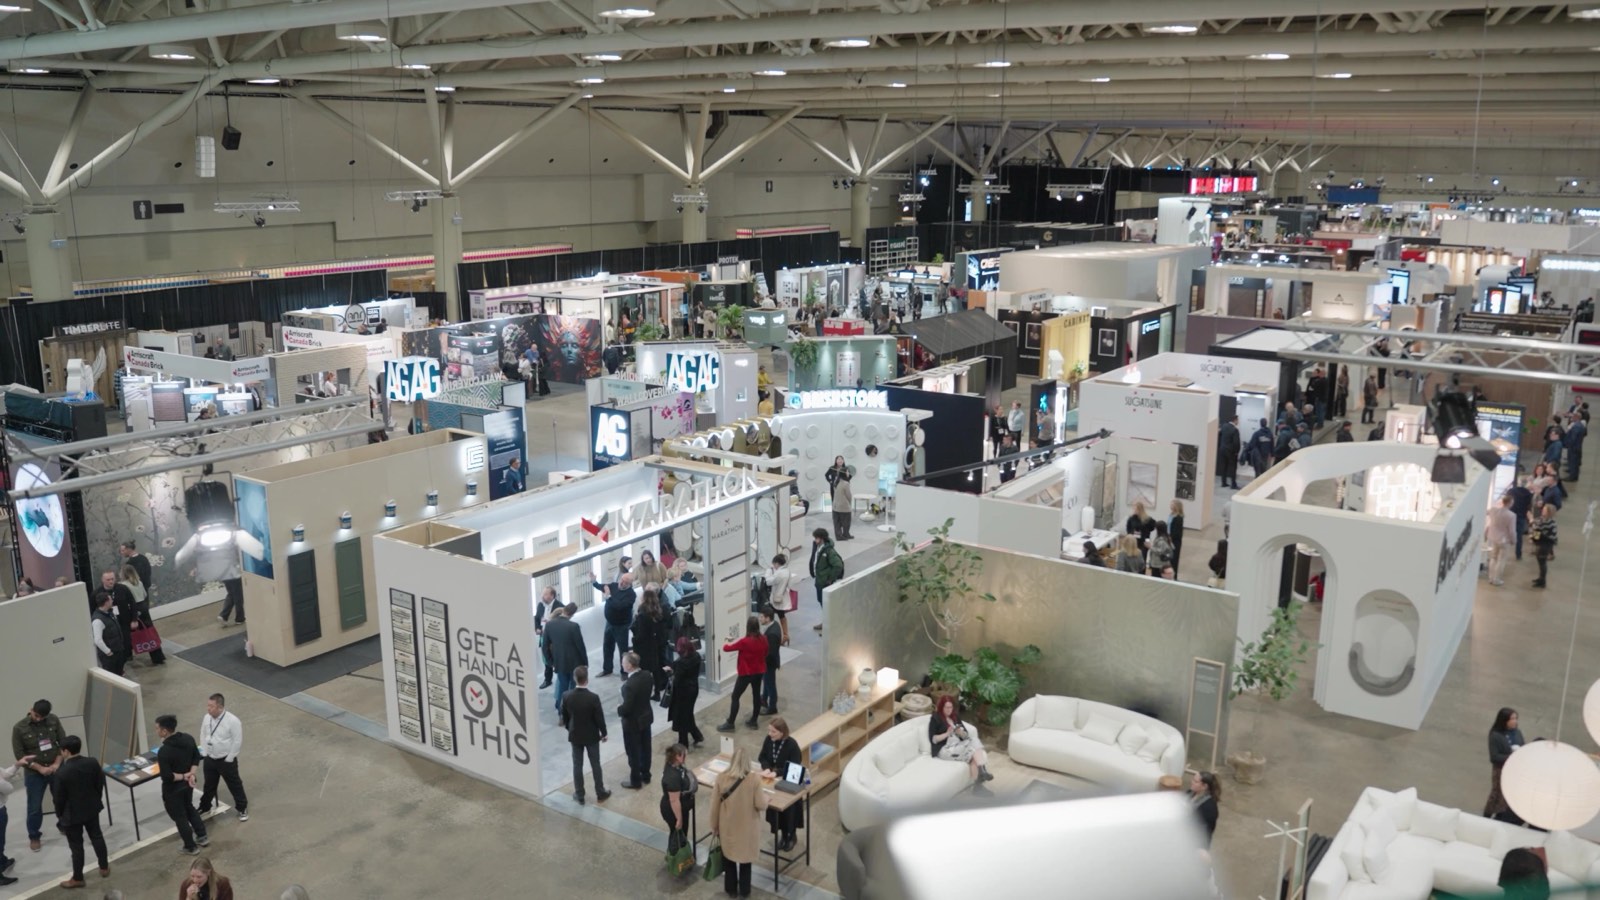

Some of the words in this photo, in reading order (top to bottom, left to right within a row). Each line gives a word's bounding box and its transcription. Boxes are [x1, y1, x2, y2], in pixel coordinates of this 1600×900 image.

[718, 255, 739, 264] PROTEK
[62, 320, 120, 335] TIMBERLITE
[288, 337, 308, 346] Canada
[308, 339, 322, 347] Brick
[131, 350, 154, 361] Arriscraft
[131, 358, 150, 368] Canada
[150, 360, 164, 370] Brick
[1200, 363, 1233, 374] SUGATSUNE
[1124, 396, 1163, 409] SUGATSUNE
[595, 413, 628, 457] AG
[613, 464, 760, 539] MARATHON
[711, 524, 744, 541] MARATHON
[136, 640, 157, 653] EQ3
[457, 627, 498, 659] GET
[507, 642, 523, 668] A
[458, 651, 525, 688] HANDLE
[461, 674, 527, 734] ON
[463, 714, 530, 765] THIS
